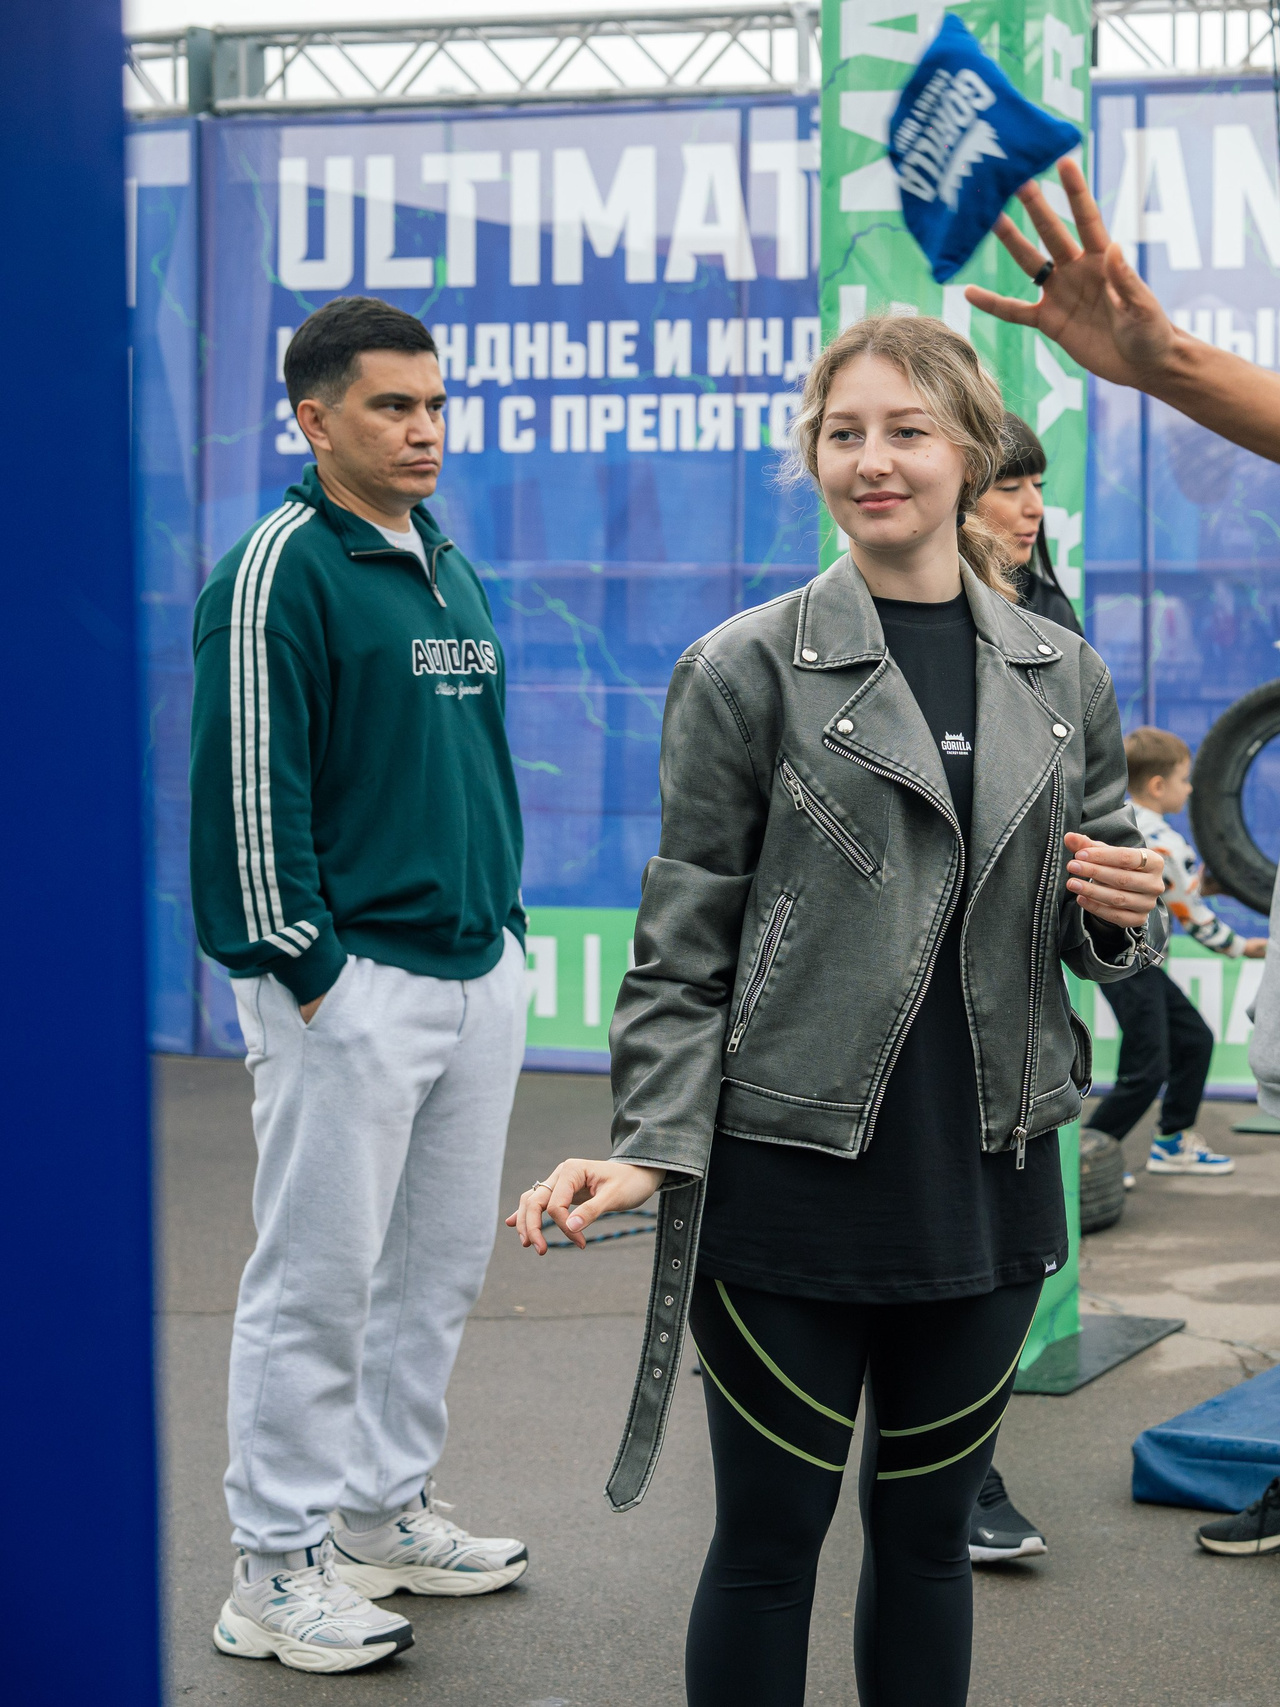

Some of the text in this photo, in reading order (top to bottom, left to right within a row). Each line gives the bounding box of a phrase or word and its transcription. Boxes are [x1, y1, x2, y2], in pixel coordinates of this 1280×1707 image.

[278, 141, 821, 290] ULTIMAT
[654, 319, 692, 378] И
[941, 740, 972, 751] GORILLA
